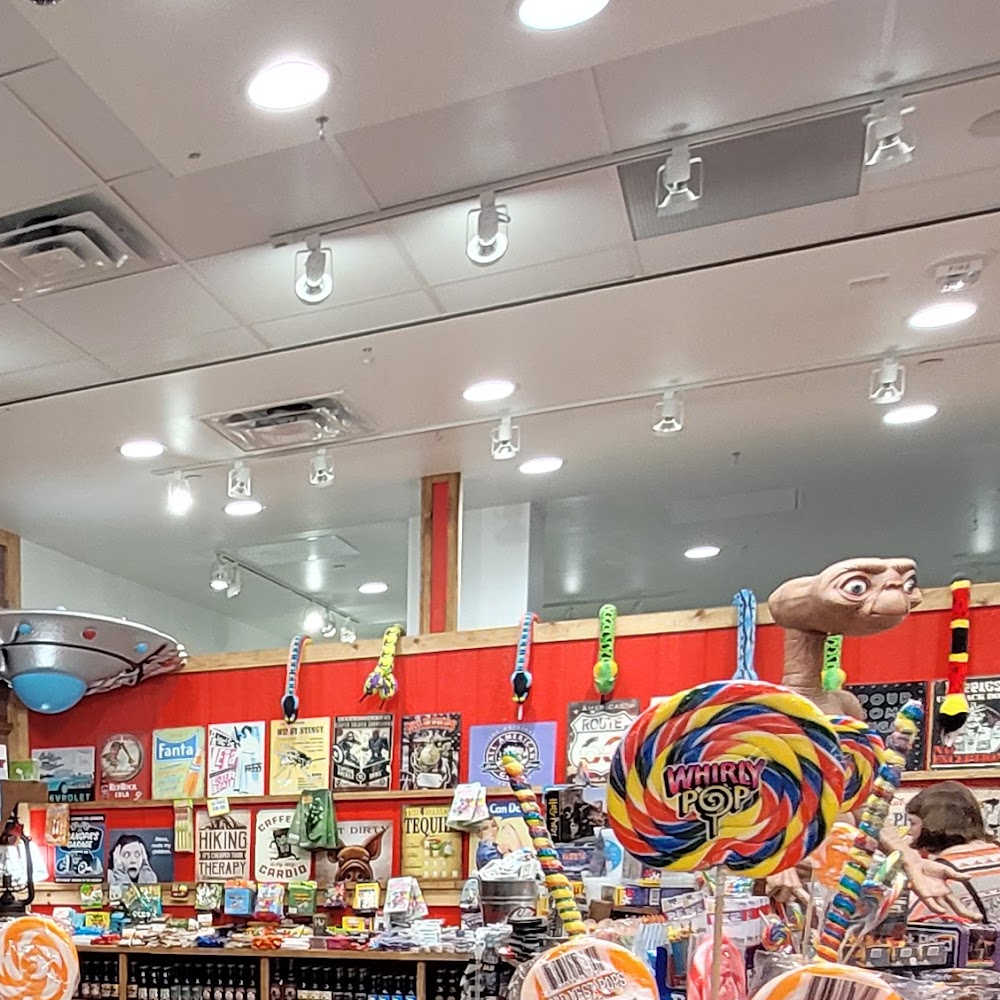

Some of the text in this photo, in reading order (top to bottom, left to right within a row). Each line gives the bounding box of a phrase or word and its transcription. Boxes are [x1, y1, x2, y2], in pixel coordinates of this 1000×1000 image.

[581, 716, 626, 732] ROUTE
[499, 732, 537, 760] AMERICAN
[664, 758, 767, 796] WHIRLY
[489, 803, 508, 813] Can
[680, 785, 751, 821] POP
[350, 824, 390, 836] DIRTY
[199, 832, 248, 850] HIKING
[199, 861, 247, 876] THERAPY
[258, 864, 308, 880] CARDIO
